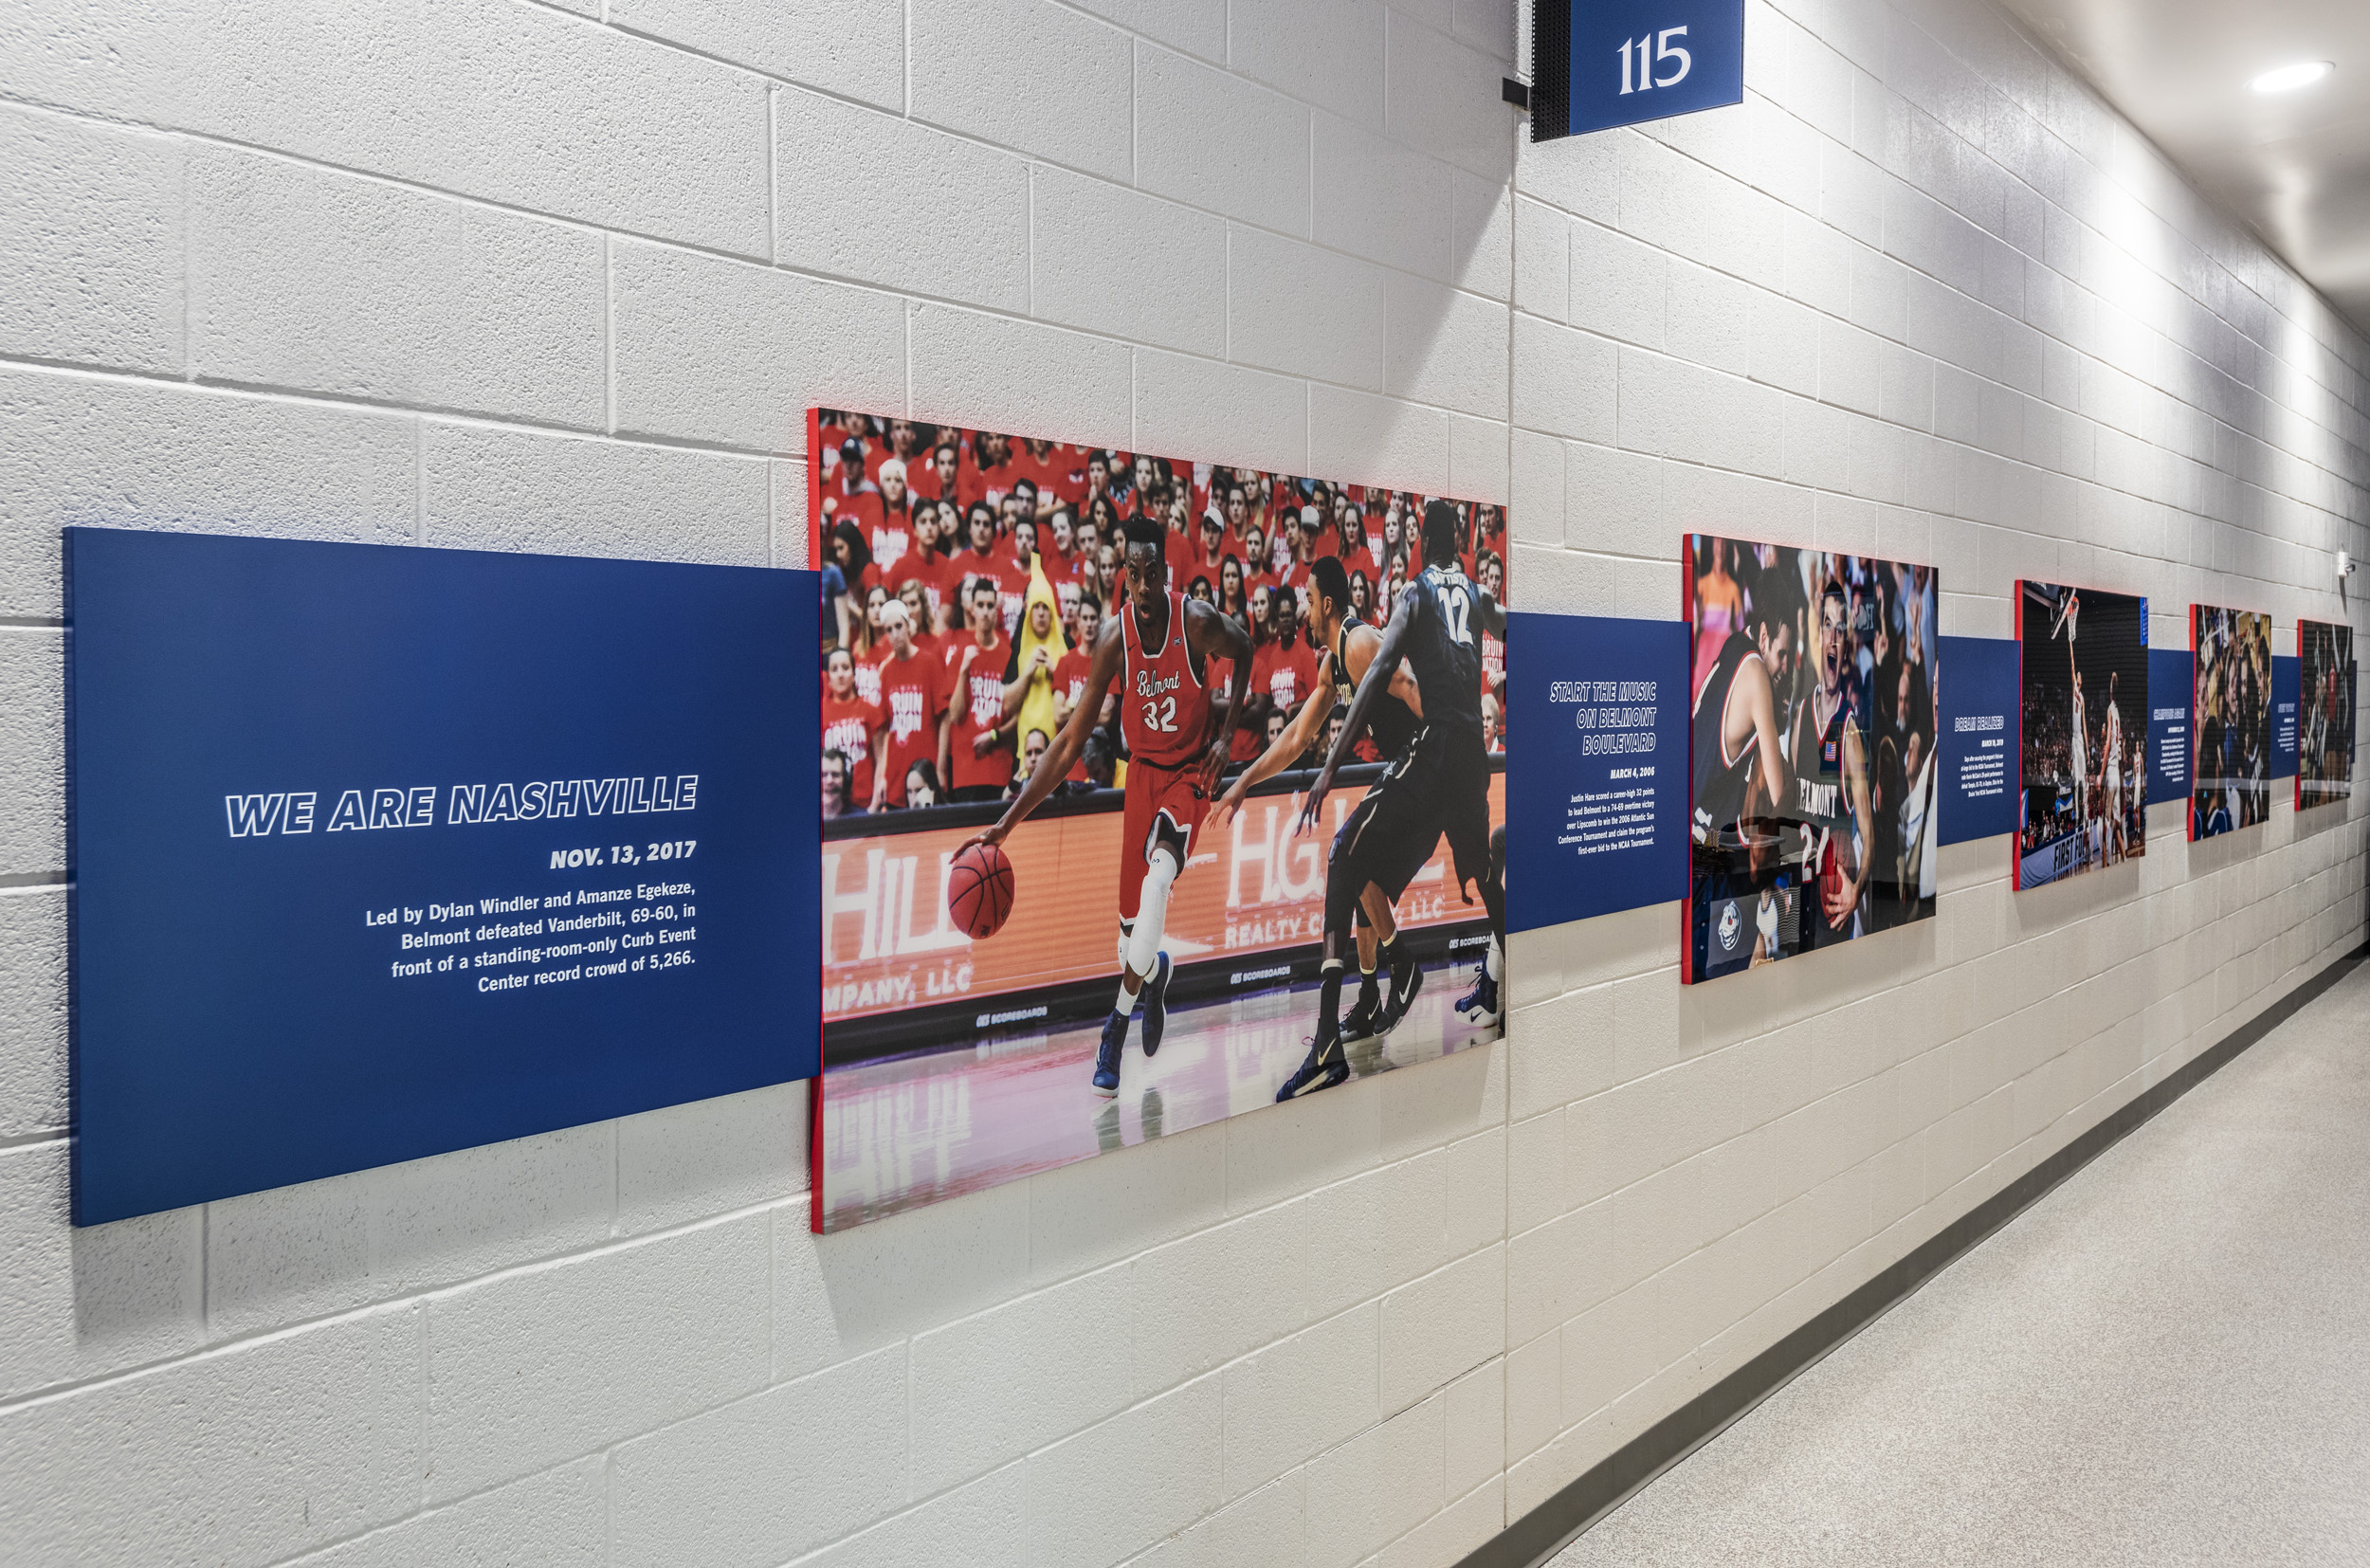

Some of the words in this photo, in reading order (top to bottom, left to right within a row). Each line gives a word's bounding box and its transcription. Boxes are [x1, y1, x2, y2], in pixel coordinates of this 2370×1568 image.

[1616, 25, 1691, 95] 115
[1437, 586, 1473, 645] 12
[1483, 639, 1504, 657] BRUIN
[1483, 656, 1504, 672] NATION
[1137, 669, 1179, 697] Belmont
[1550, 682, 1591, 702] START
[1593, 682, 1616, 702] THE
[1618, 682, 1656, 702] MUSIC
[1141, 697, 1178, 732] 32
[1577, 708, 1596, 729] ON
[1599, 707, 1657, 728] BELMONT
[1582, 733, 1655, 756] BOULEVARD
[1611, 768, 1632, 779] MARCH
[1632, 768, 1638, 778] 4,
[1640, 766, 1654, 776] 2006
[226, 793, 317, 837] WE
[326, 788, 436, 831] ARE
[448, 776, 698, 824] NASHVILLE
[1584, 806, 1601, 814] Belmont
[1612, 803, 1624, 811] 74-69
[1642, 800, 1654, 809] victory
[1595, 792, 1609, 800] scored
[1613, 790, 1635, 798] career-high
[1643, 788, 1654, 797] points
[1796, 777, 1837, 818] ELMONT
[1559, 835, 1582, 844] Conference
[1583, 830, 1607, 841] Tournament
[1636, 825, 1654, 835] program's
[1577, 819, 1597, 830] Lipscomb
[1631, 813, 1646, 822] Atlantic
[550, 848, 603, 868] NOV.
[611, 846, 641, 865] 13,
[647, 841, 696, 861] 2017
[1618, 840, 1630, 848] NCAA
[1631, 837, 1653, 847] Tournament.
[2053, 837, 2074, 872] FIRST
[367, 908, 396, 926] Led
[404, 907, 423, 925] by
[429, 903, 474, 921] Dylan
[480, 896, 538, 914] Windler
[544, 891, 571, 907] and
[576, 889, 631, 904] Amanze
[638, 883, 695, 901] Egekeze,
[1411, 897, 1444, 921] LLC
[402, 928, 470, 949] Belmont
[476, 920, 542, 940] defeated
[548, 912, 625, 932] Vanderbilt,
[631, 905, 678, 922] 69-60,
[684, 903, 695, 917] in
[1225, 916, 1302, 949] REALTY
[392, 958, 432, 977] front
[438, 956, 453, 971] of
[460, 957, 468, 969] a
[475, 937, 617, 963] standing-room-only
[622, 932, 654, 948] Curb
[660, 927, 696, 943] Event
[1460, 935, 1490, 947] SCOREBOA
[479, 975, 529, 992] Center
[535, 965, 579, 984] record
[586, 959, 626, 977] crowd
[631, 957, 645, 971] of
[650, 951, 695, 970] 5,266.
[927, 964, 973, 995] LLC
